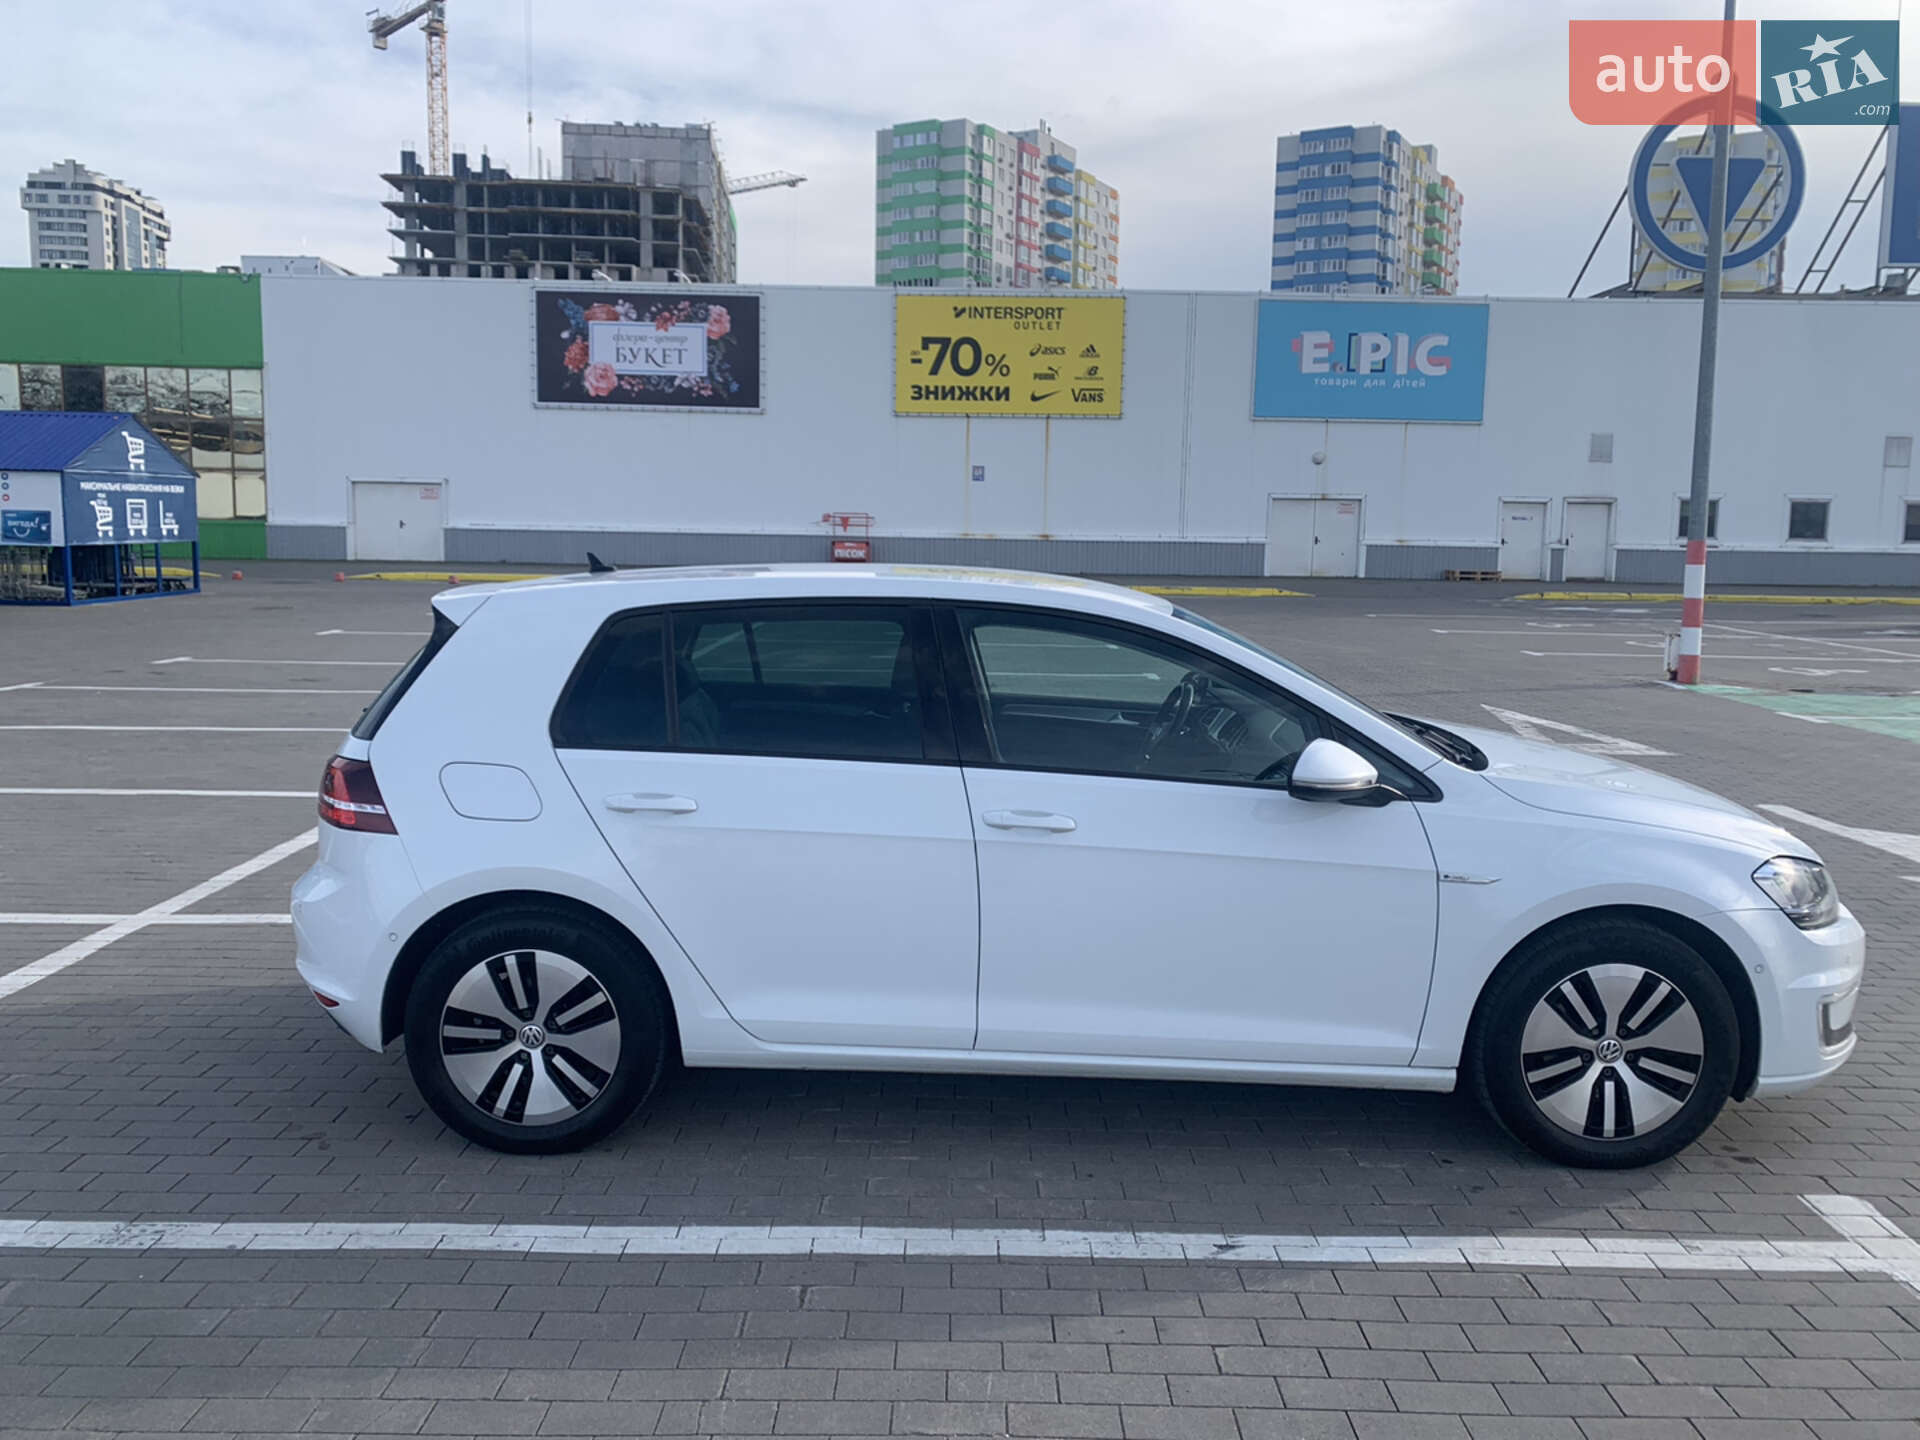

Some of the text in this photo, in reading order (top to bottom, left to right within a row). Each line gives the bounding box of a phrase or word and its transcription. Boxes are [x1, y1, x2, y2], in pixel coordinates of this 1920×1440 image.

[968, 306, 1064, 320] INTERSPORT
[1014, 321, 1061, 330] OUTLET
[616, 347, 688, 368] БУКЕТ
[1314, 378, 1357, 389] товари
[1363, 379, 1386, 389] для
[910, 384, 1010, 401] ЗНИЖКИ
